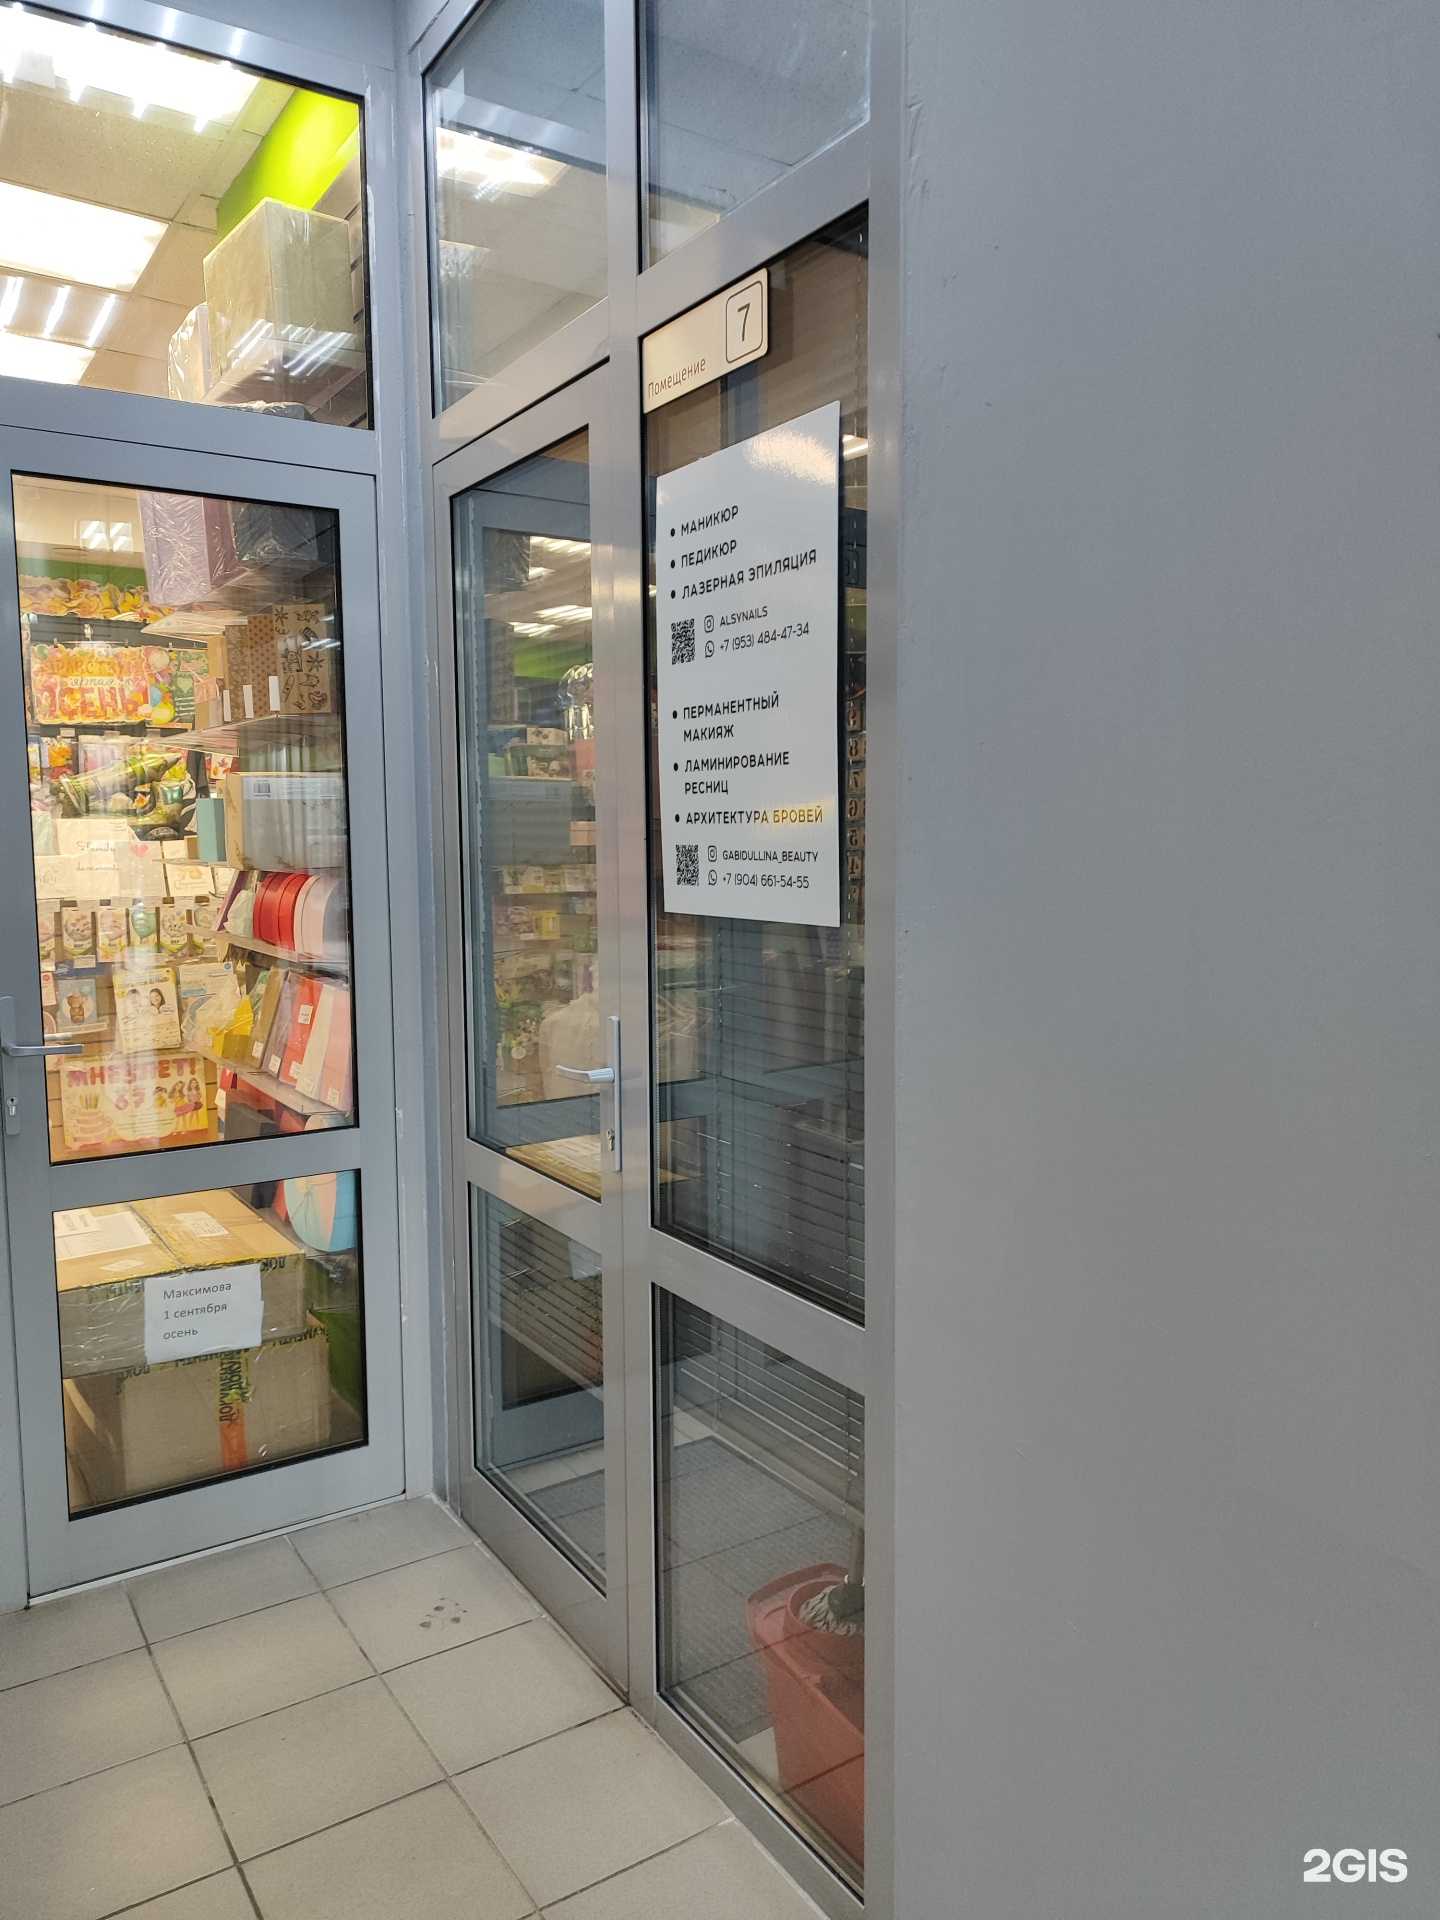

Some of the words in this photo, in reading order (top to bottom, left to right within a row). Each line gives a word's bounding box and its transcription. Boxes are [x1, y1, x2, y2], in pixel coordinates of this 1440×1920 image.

[736, 302, 751, 342] 7
[648, 358, 706, 400] Помещение
[681, 505, 739, 537] МАНИКЮР
[681, 539, 737, 569] ПЕДИКЮР
[682, 570, 744, 600] ЛАЗЕРНАЯ
[748, 549, 817, 582] ЭПИЛЯЦИЯ
[719, 606, 768, 627] ALSYNAILS
[719, 640, 730, 652] +7
[732, 633, 755, 651] (953)
[757, 622, 810, 645] 484-47-34
[683, 691, 779, 720] ПЕРМАНЕНТНЫЙ
[683, 724, 734, 742] МАКИЯЖ
[684, 751, 790, 773] ЛАМИНИРОВАНИЕ
[684, 780, 729, 795] РЕСНИЦ
[686, 810, 769, 825] АРХИТЕКТУРА
[773, 805, 823, 824] БРОВЕЙ
[722, 850, 818, 863] GABIDULLINA_BEAUTY
[734, 873, 758, 887] (904)
[761, 874, 810, 889] 661-54-55
[163, 1282, 232, 1300] Максимова
[164, 1310, 170, 1320] 1
[174, 1303, 227, 1318] сентября
[163, 1328, 199, 1340] осень
